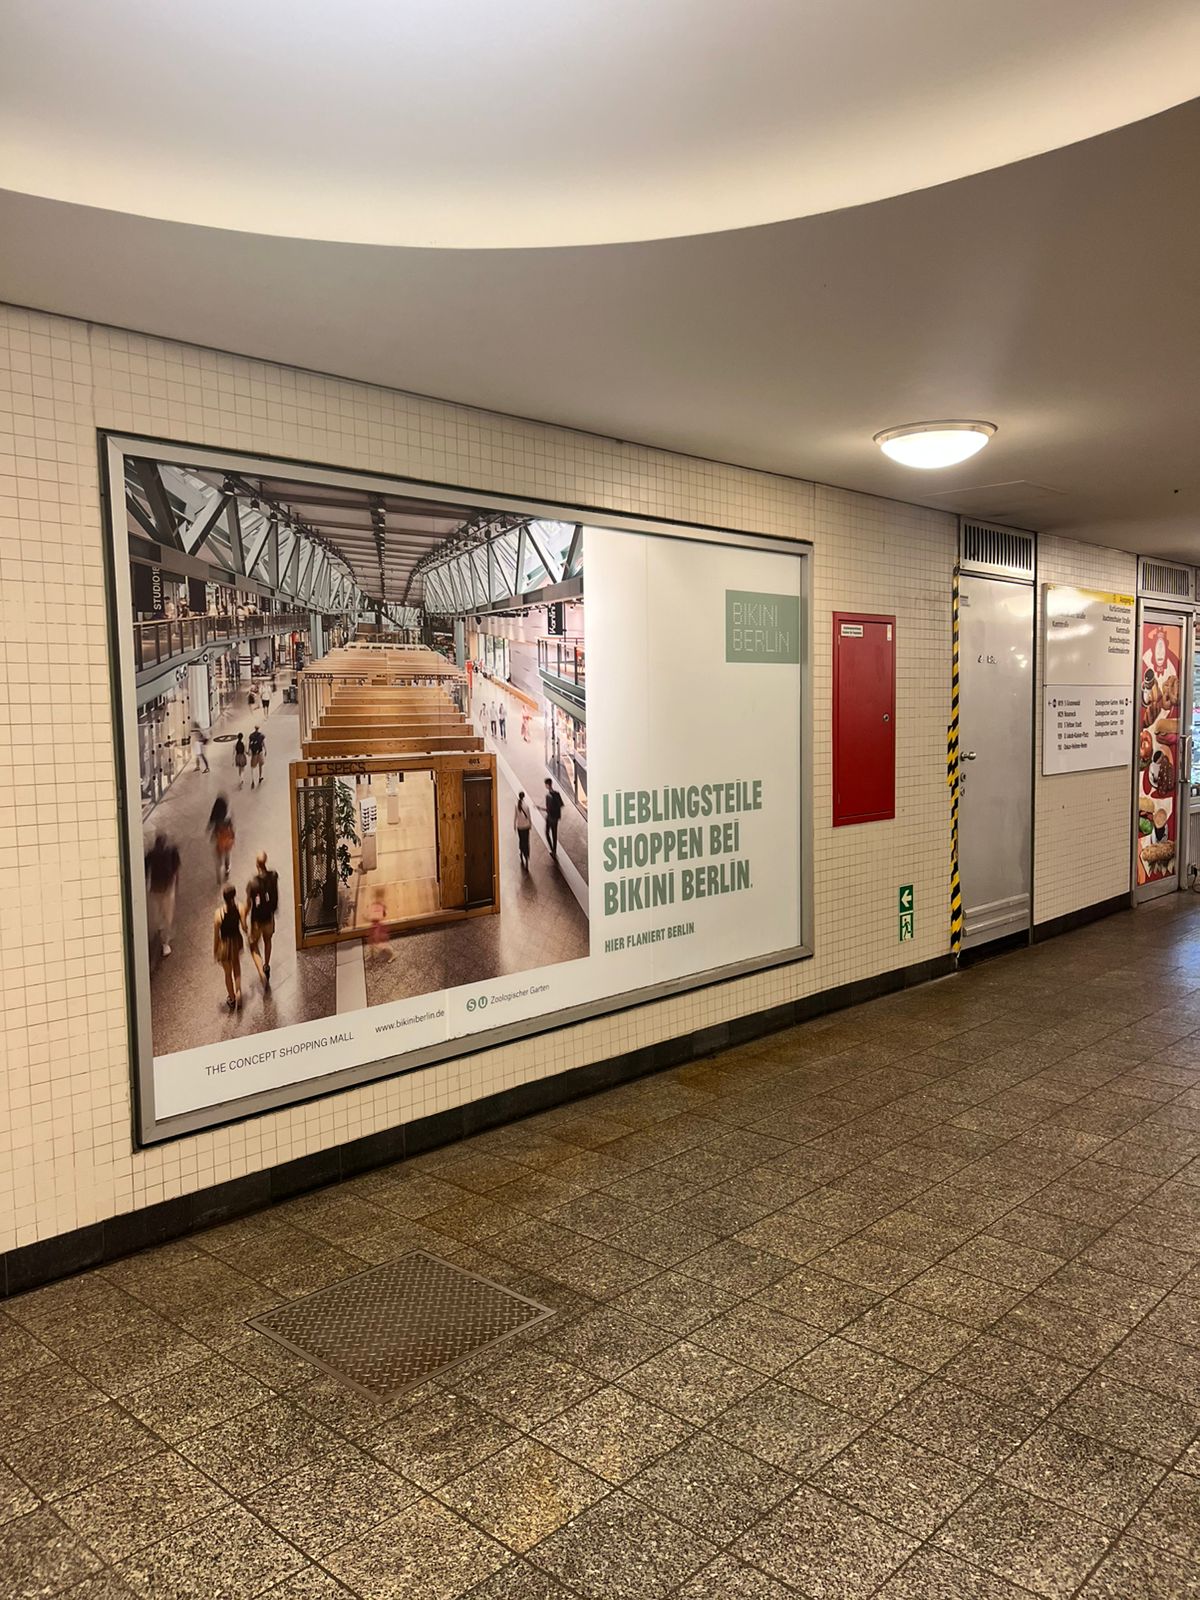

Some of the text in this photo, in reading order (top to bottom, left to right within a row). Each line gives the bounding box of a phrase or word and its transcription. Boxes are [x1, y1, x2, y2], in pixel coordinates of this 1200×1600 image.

[733, 602, 778, 627] BIKINI
[733, 629, 790, 653] BERLIN
[603, 826, 703, 872] SHOPPEN
[605, 922, 695, 953] HIER FLANIERT BERLIN
[491, 989, 529, 1005] Zoologischer
[530, 983, 550, 995] Garten
[375, 1009, 445, 1033] www.bikiniberlin.de
[205, 1031, 355, 1076] THE CONCEPT SHOPPING MALL
